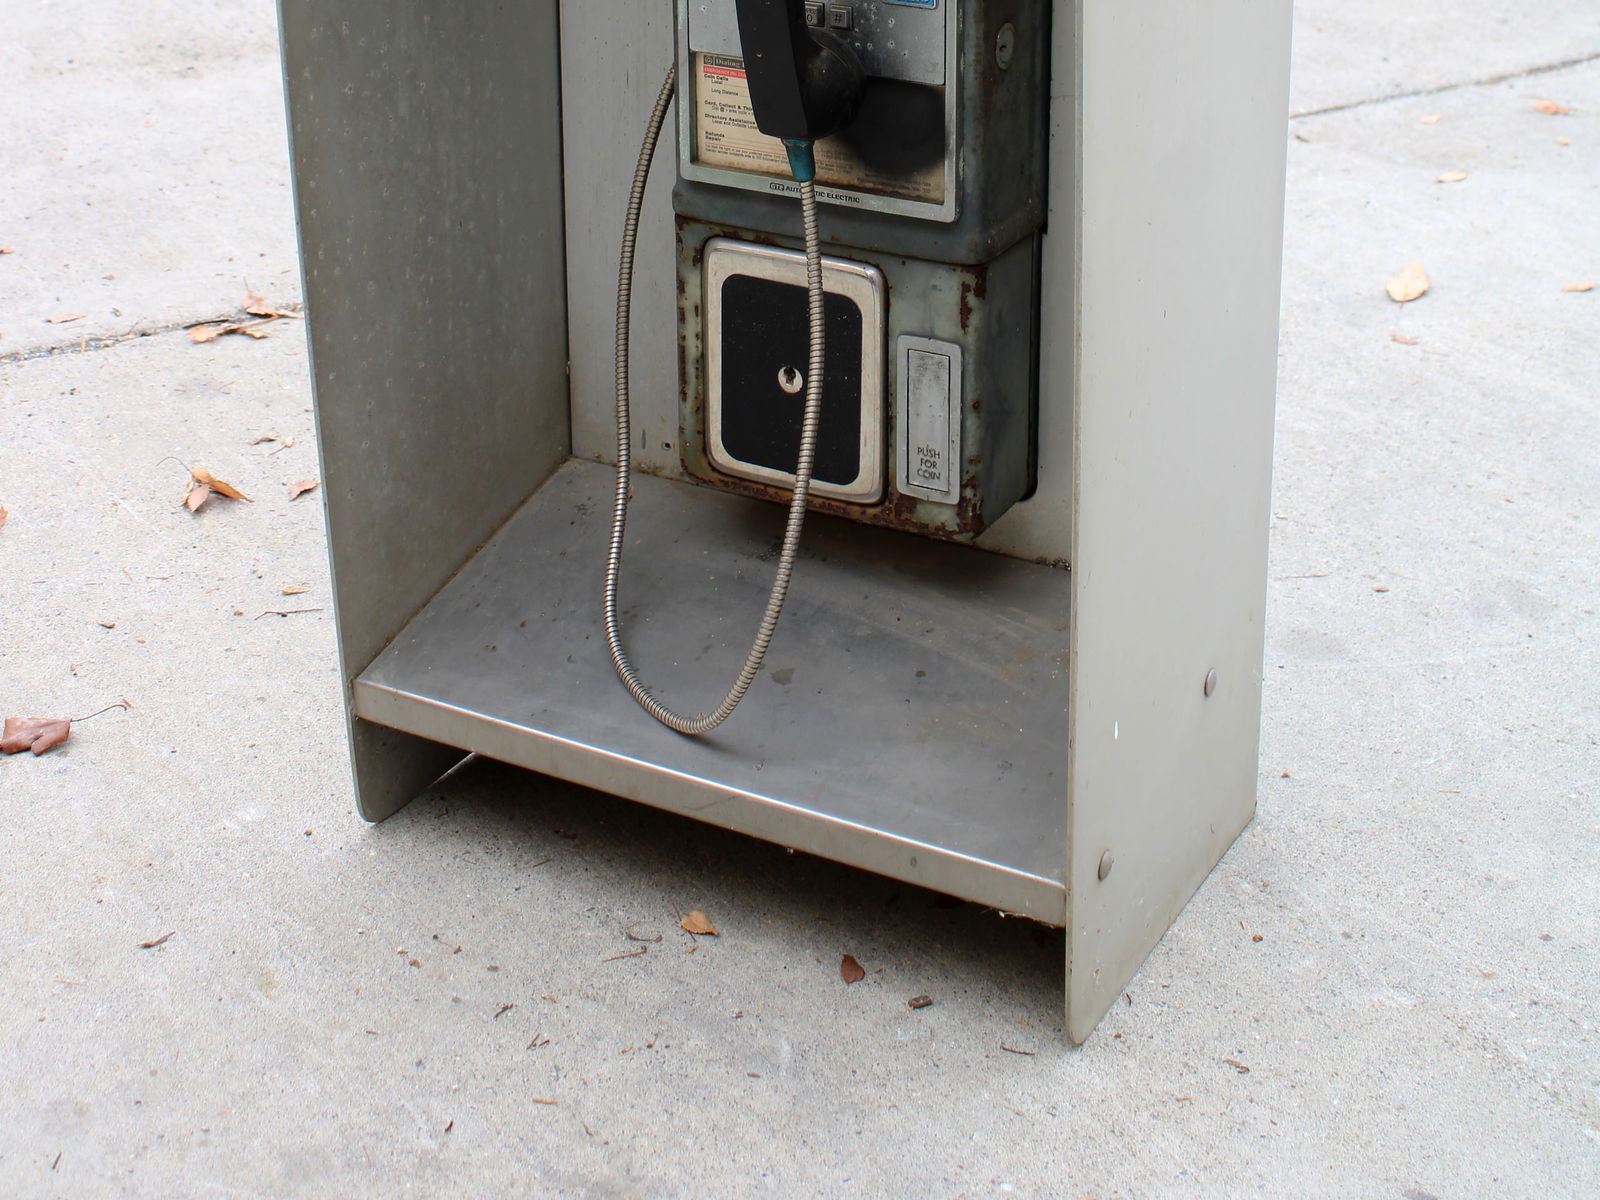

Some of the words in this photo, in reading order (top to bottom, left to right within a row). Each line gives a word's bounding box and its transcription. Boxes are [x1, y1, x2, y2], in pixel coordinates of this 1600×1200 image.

[704, 113, 727, 121] Directory
[827, 192, 860, 203] ELECTRIC
[917, 447, 940, 460] PUSH
[920, 458, 938, 470] FOR
[917, 468, 941, 481] COIN
